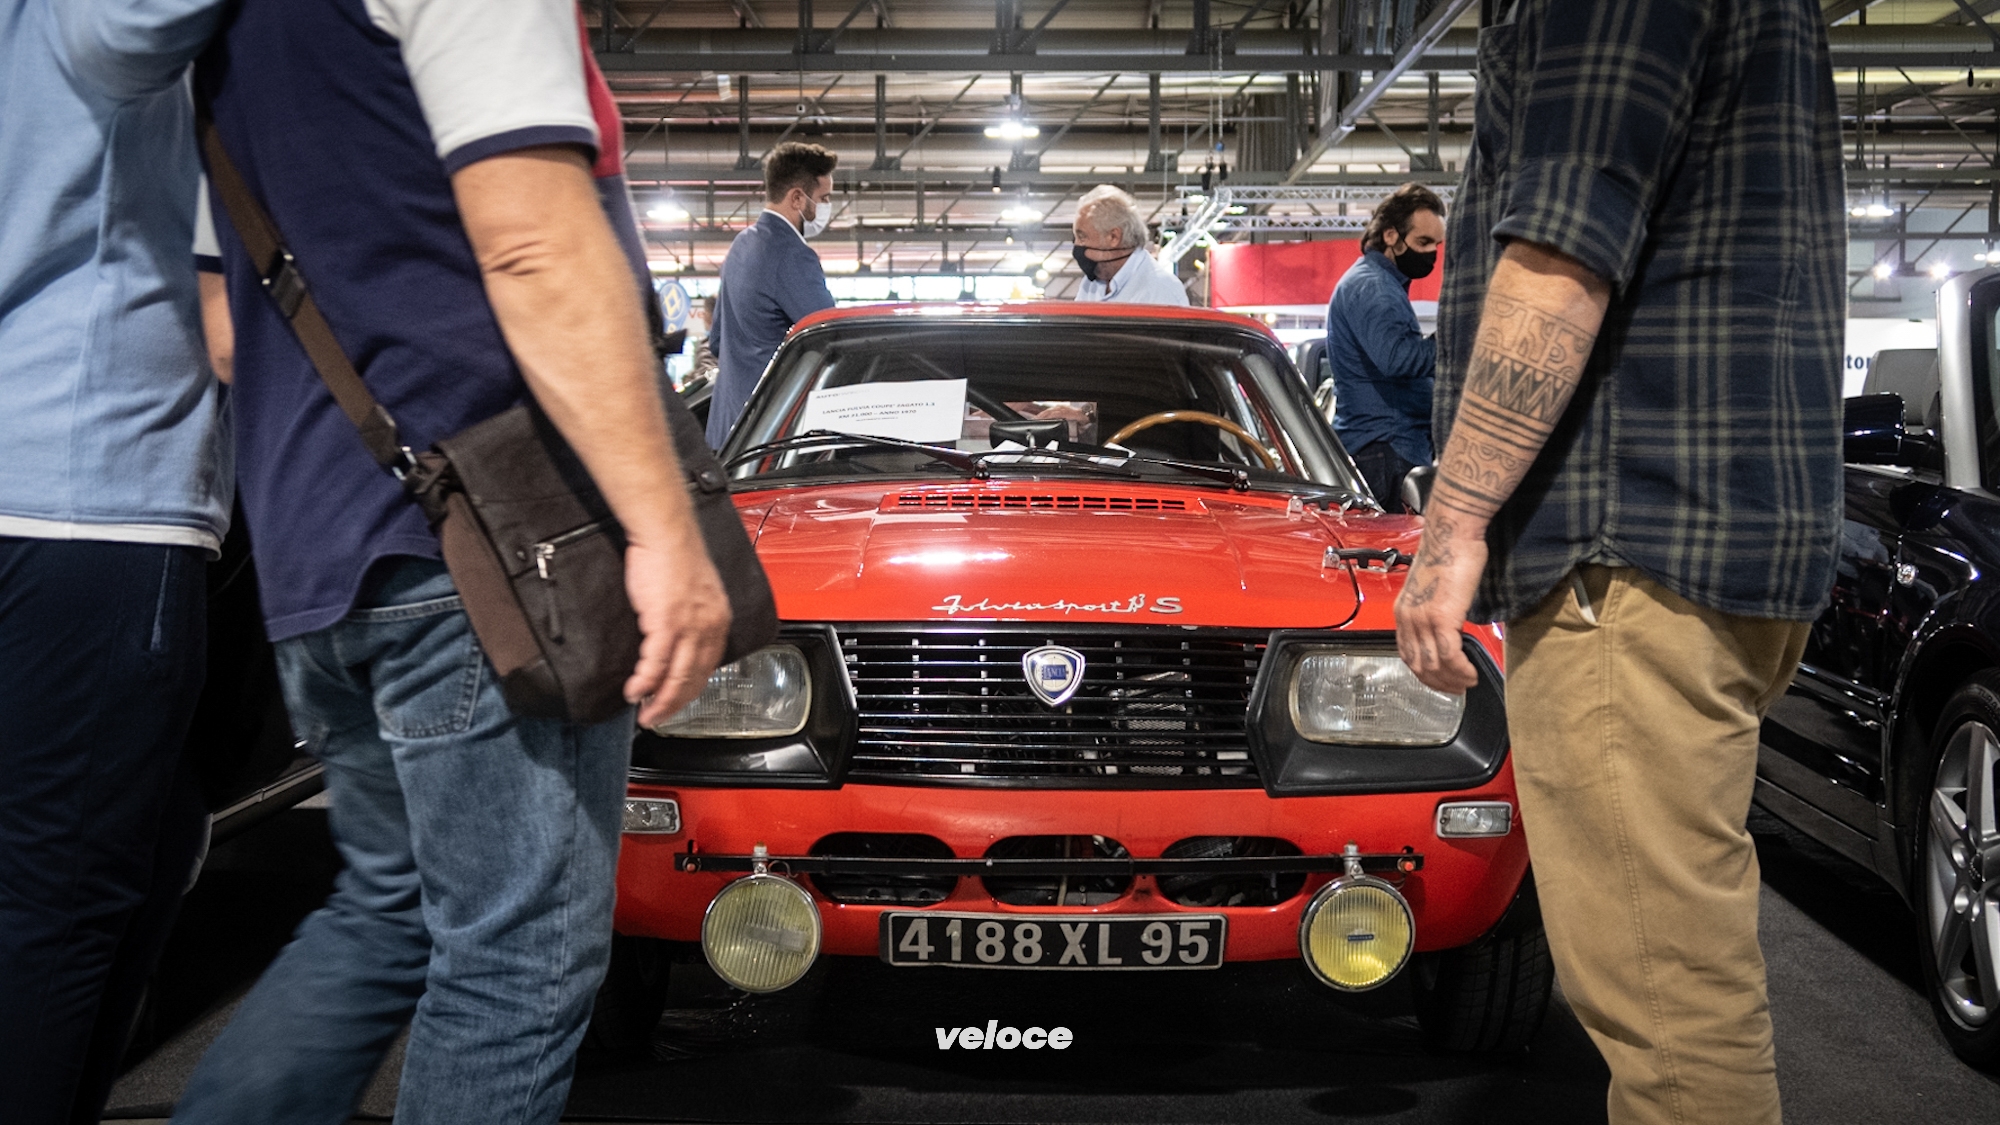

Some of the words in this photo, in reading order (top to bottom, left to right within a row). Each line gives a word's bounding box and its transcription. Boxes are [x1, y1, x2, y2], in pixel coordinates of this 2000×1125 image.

[898, 917, 1044, 965] 4188
[1057, 922, 1123, 966] XL
[1140, 921, 1212, 965] 95
